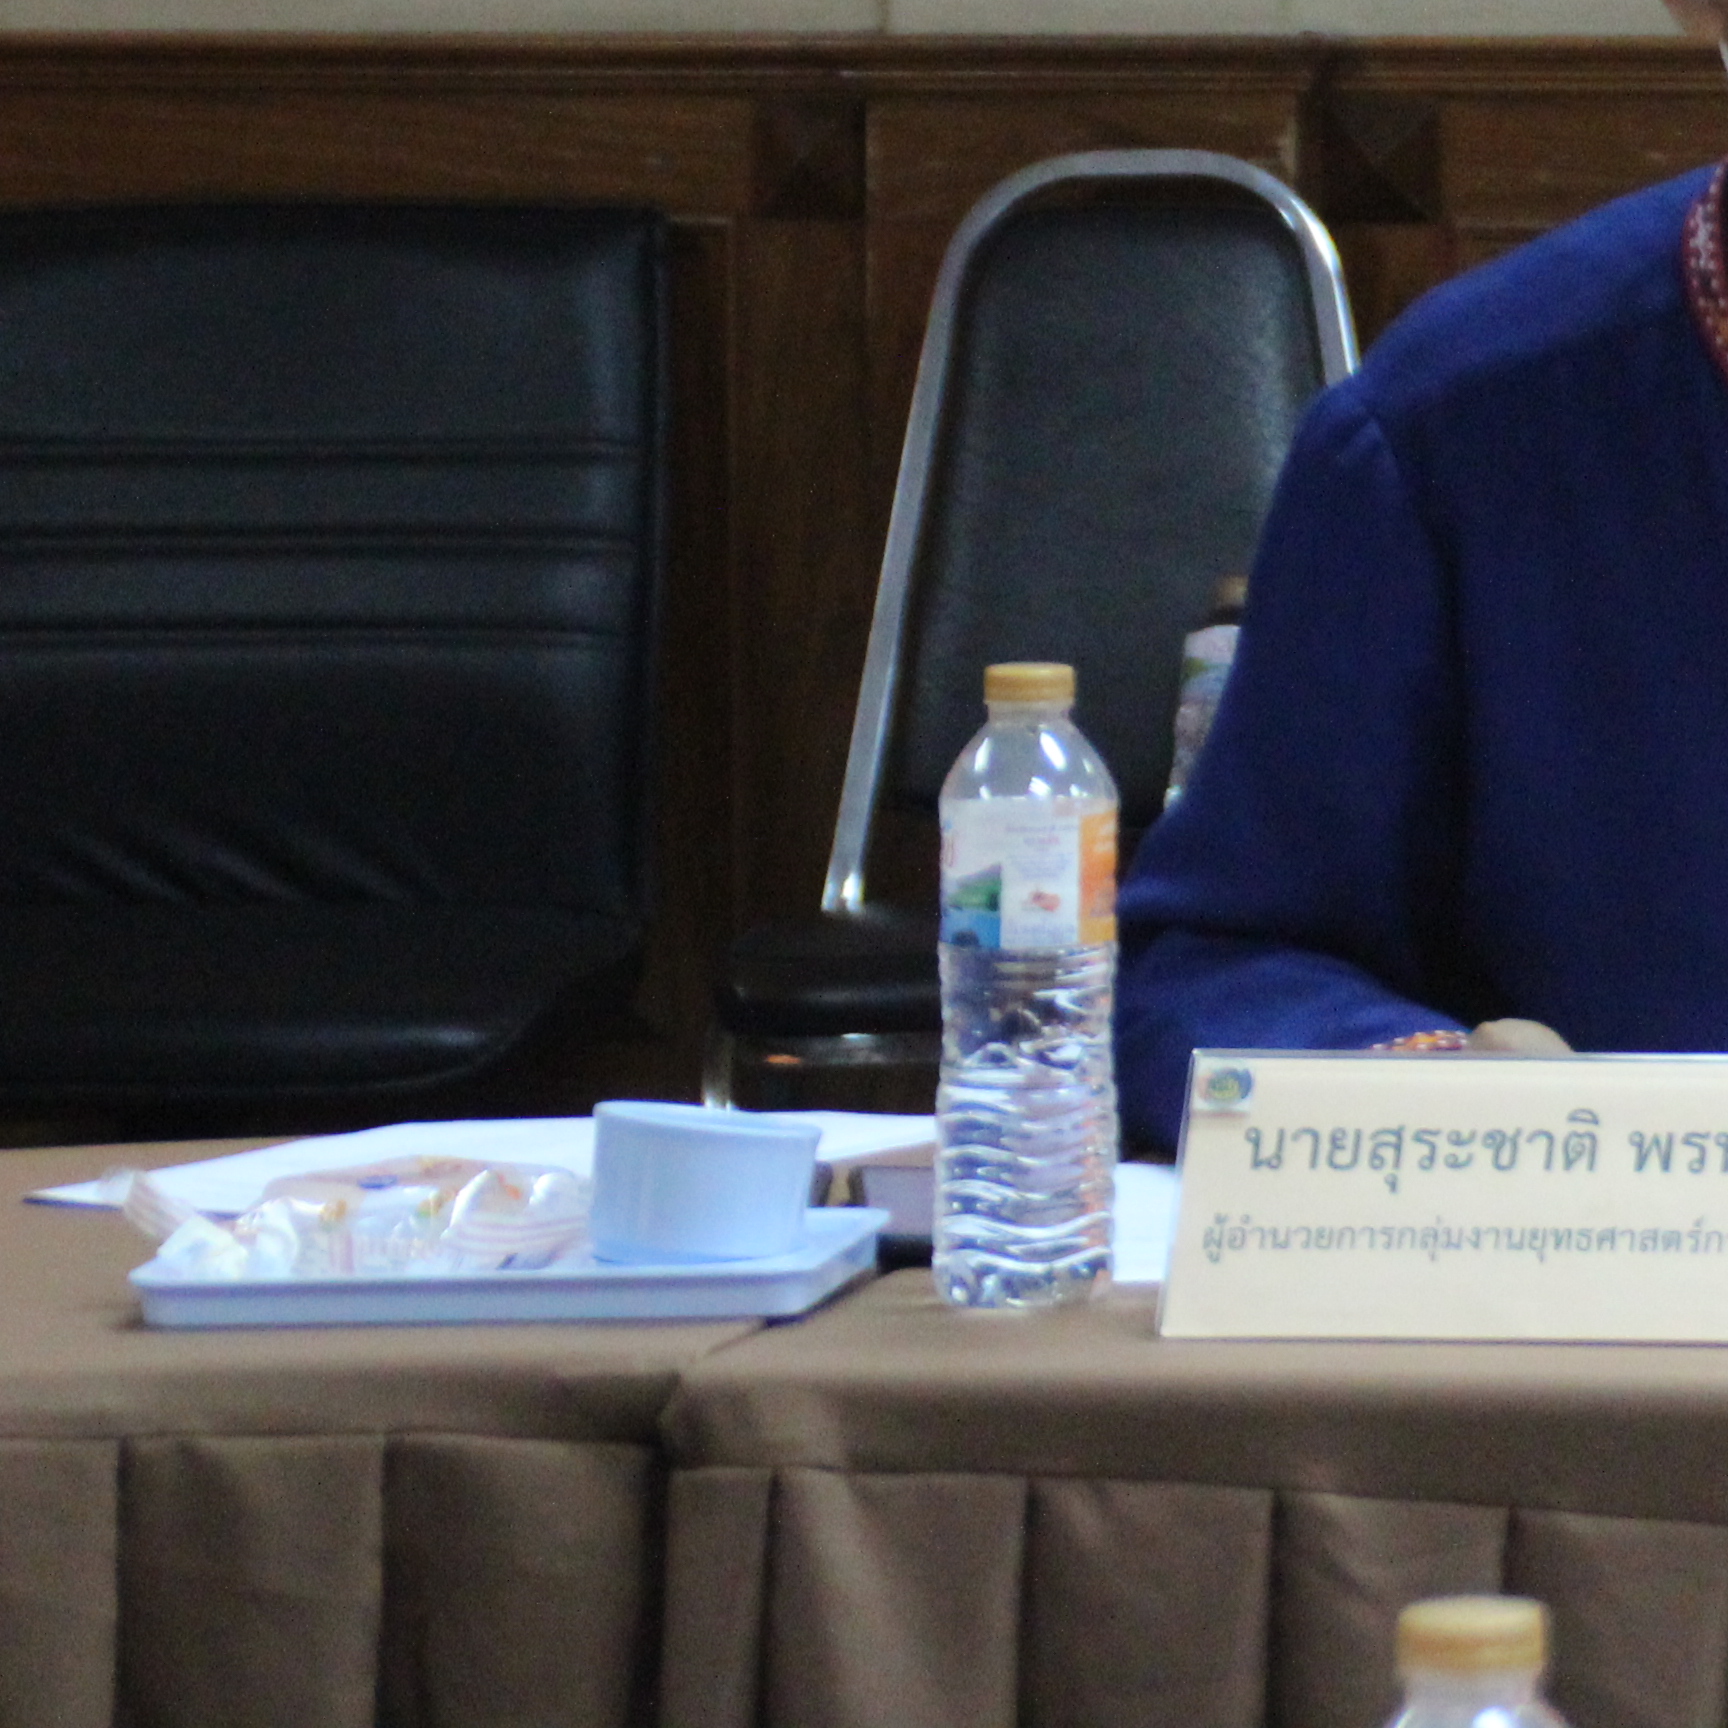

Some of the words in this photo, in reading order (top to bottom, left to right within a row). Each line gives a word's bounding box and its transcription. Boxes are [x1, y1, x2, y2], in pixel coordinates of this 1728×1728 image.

[1244, 1107, 1600, 1195] นายสุระชาติ
